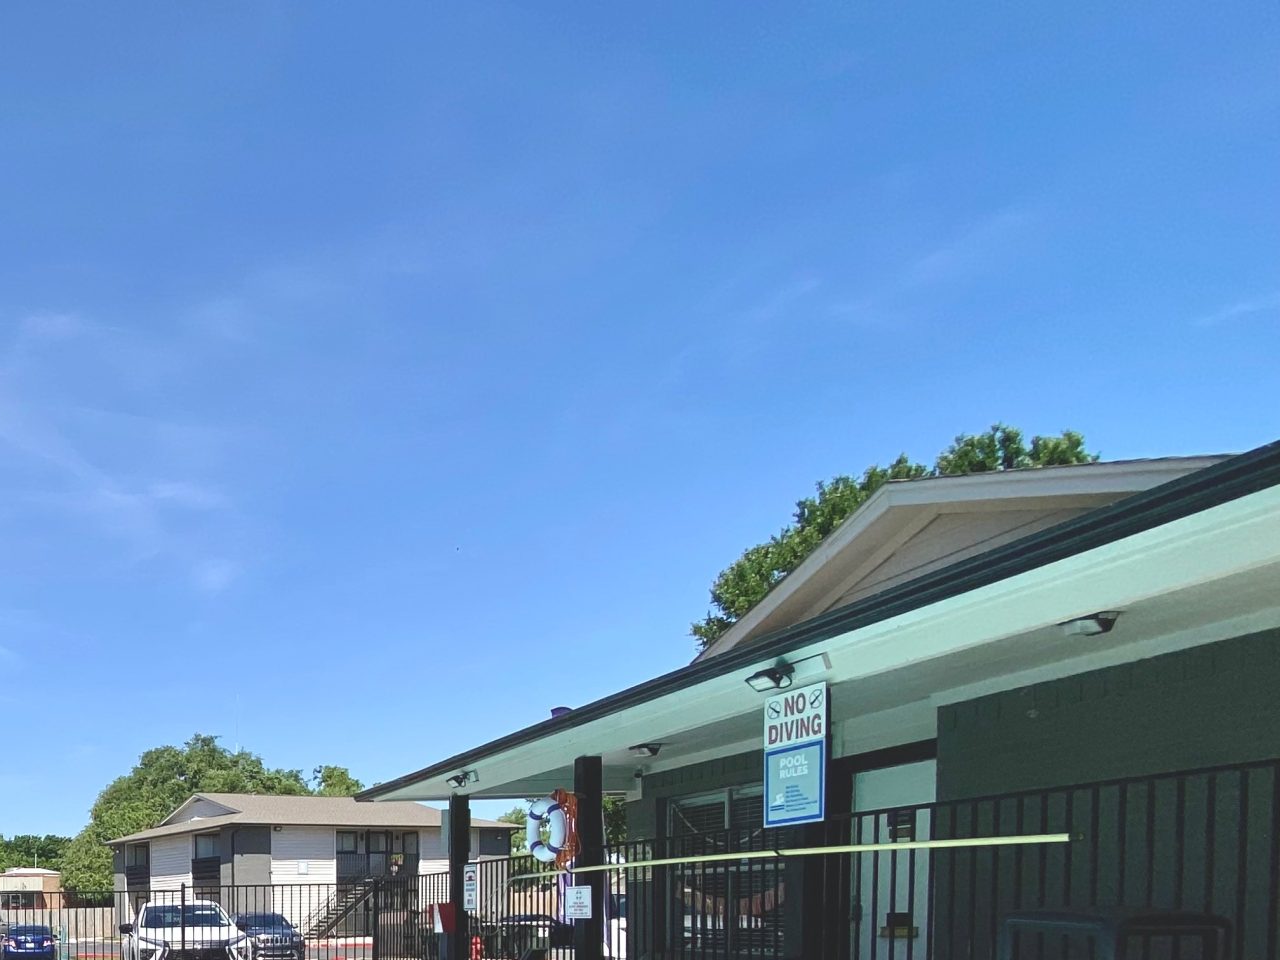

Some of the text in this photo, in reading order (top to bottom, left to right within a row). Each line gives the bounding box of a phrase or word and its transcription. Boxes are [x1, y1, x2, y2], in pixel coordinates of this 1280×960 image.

[784, 692, 807, 718] NO
[768, 713, 822, 745] DIVING
[780, 755, 808, 768] POOL
[780, 766, 808, 779] RULES
